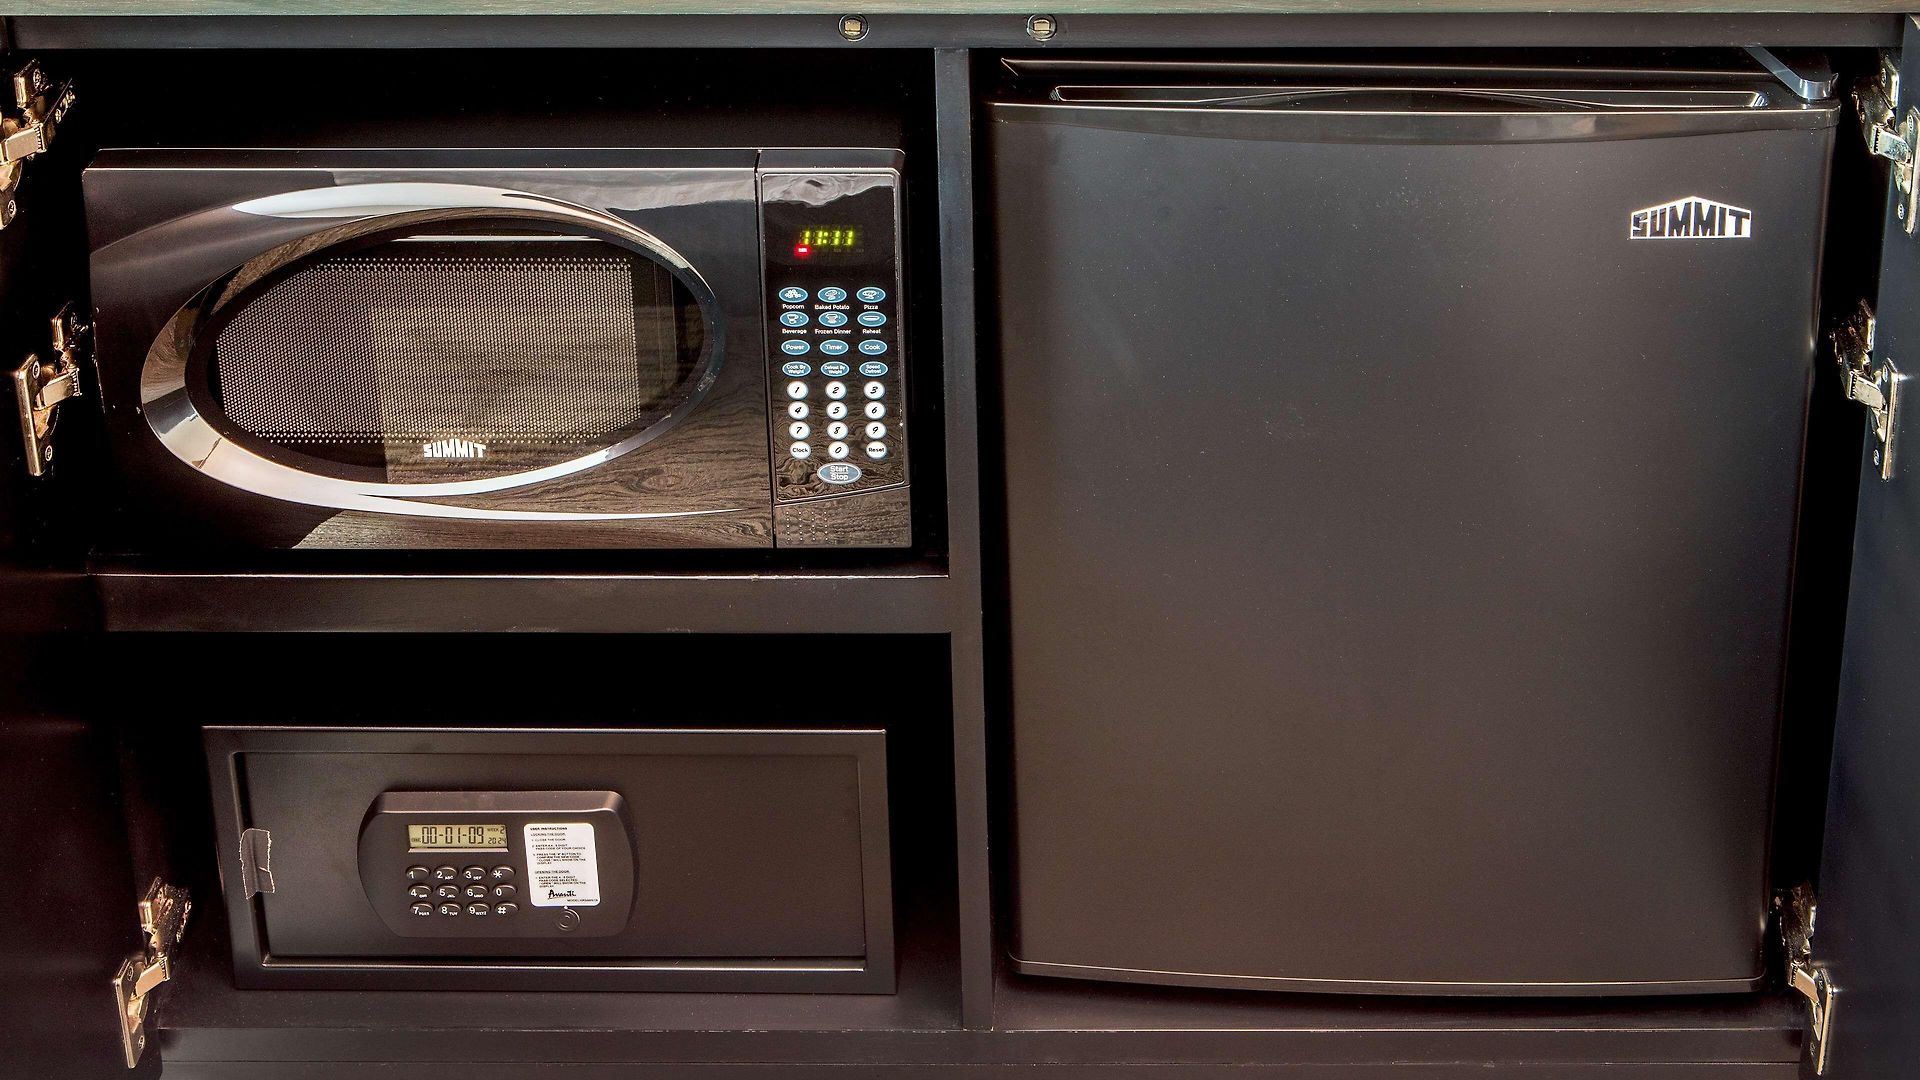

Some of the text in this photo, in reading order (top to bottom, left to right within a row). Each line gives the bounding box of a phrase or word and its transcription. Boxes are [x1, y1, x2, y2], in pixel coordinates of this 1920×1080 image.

[1632, 201, 1751, 237] SUMMIT
[423, 439, 487, 458] SUMMIT
[830, 473, 849, 481] Stop
[421, 826, 484, 844] 00-01-09
